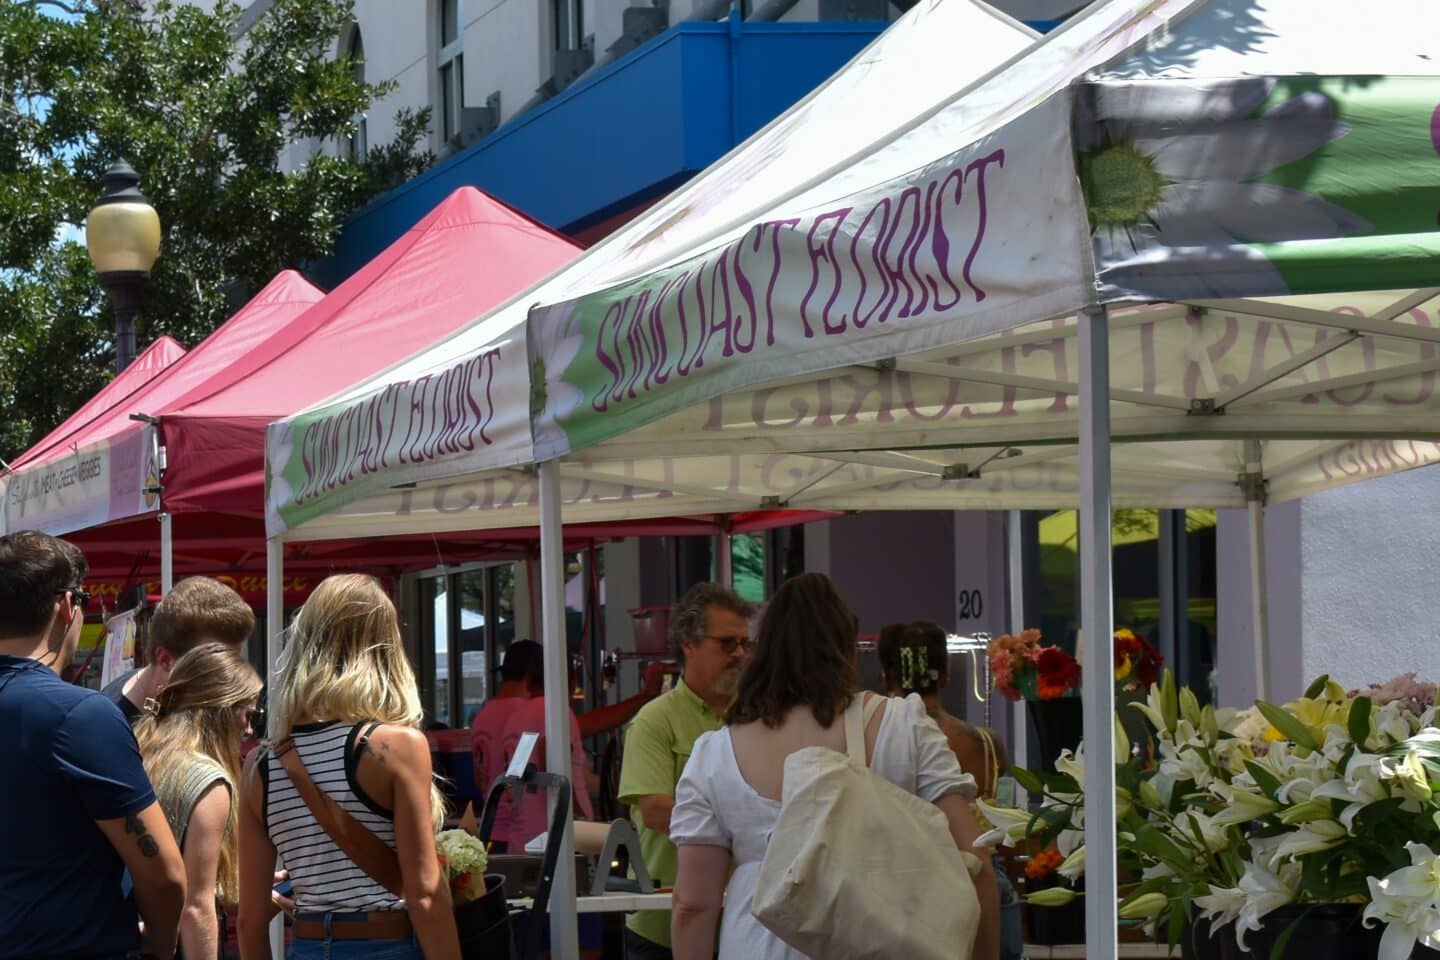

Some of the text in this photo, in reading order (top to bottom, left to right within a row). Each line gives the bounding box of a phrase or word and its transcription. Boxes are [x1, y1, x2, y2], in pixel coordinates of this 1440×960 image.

[592, 148, 1005, 412] SUNCOAST FLORIST
[295, 347, 502, 505] SUNCOAST FLORIST
[959, 590, 982, 620] 20
